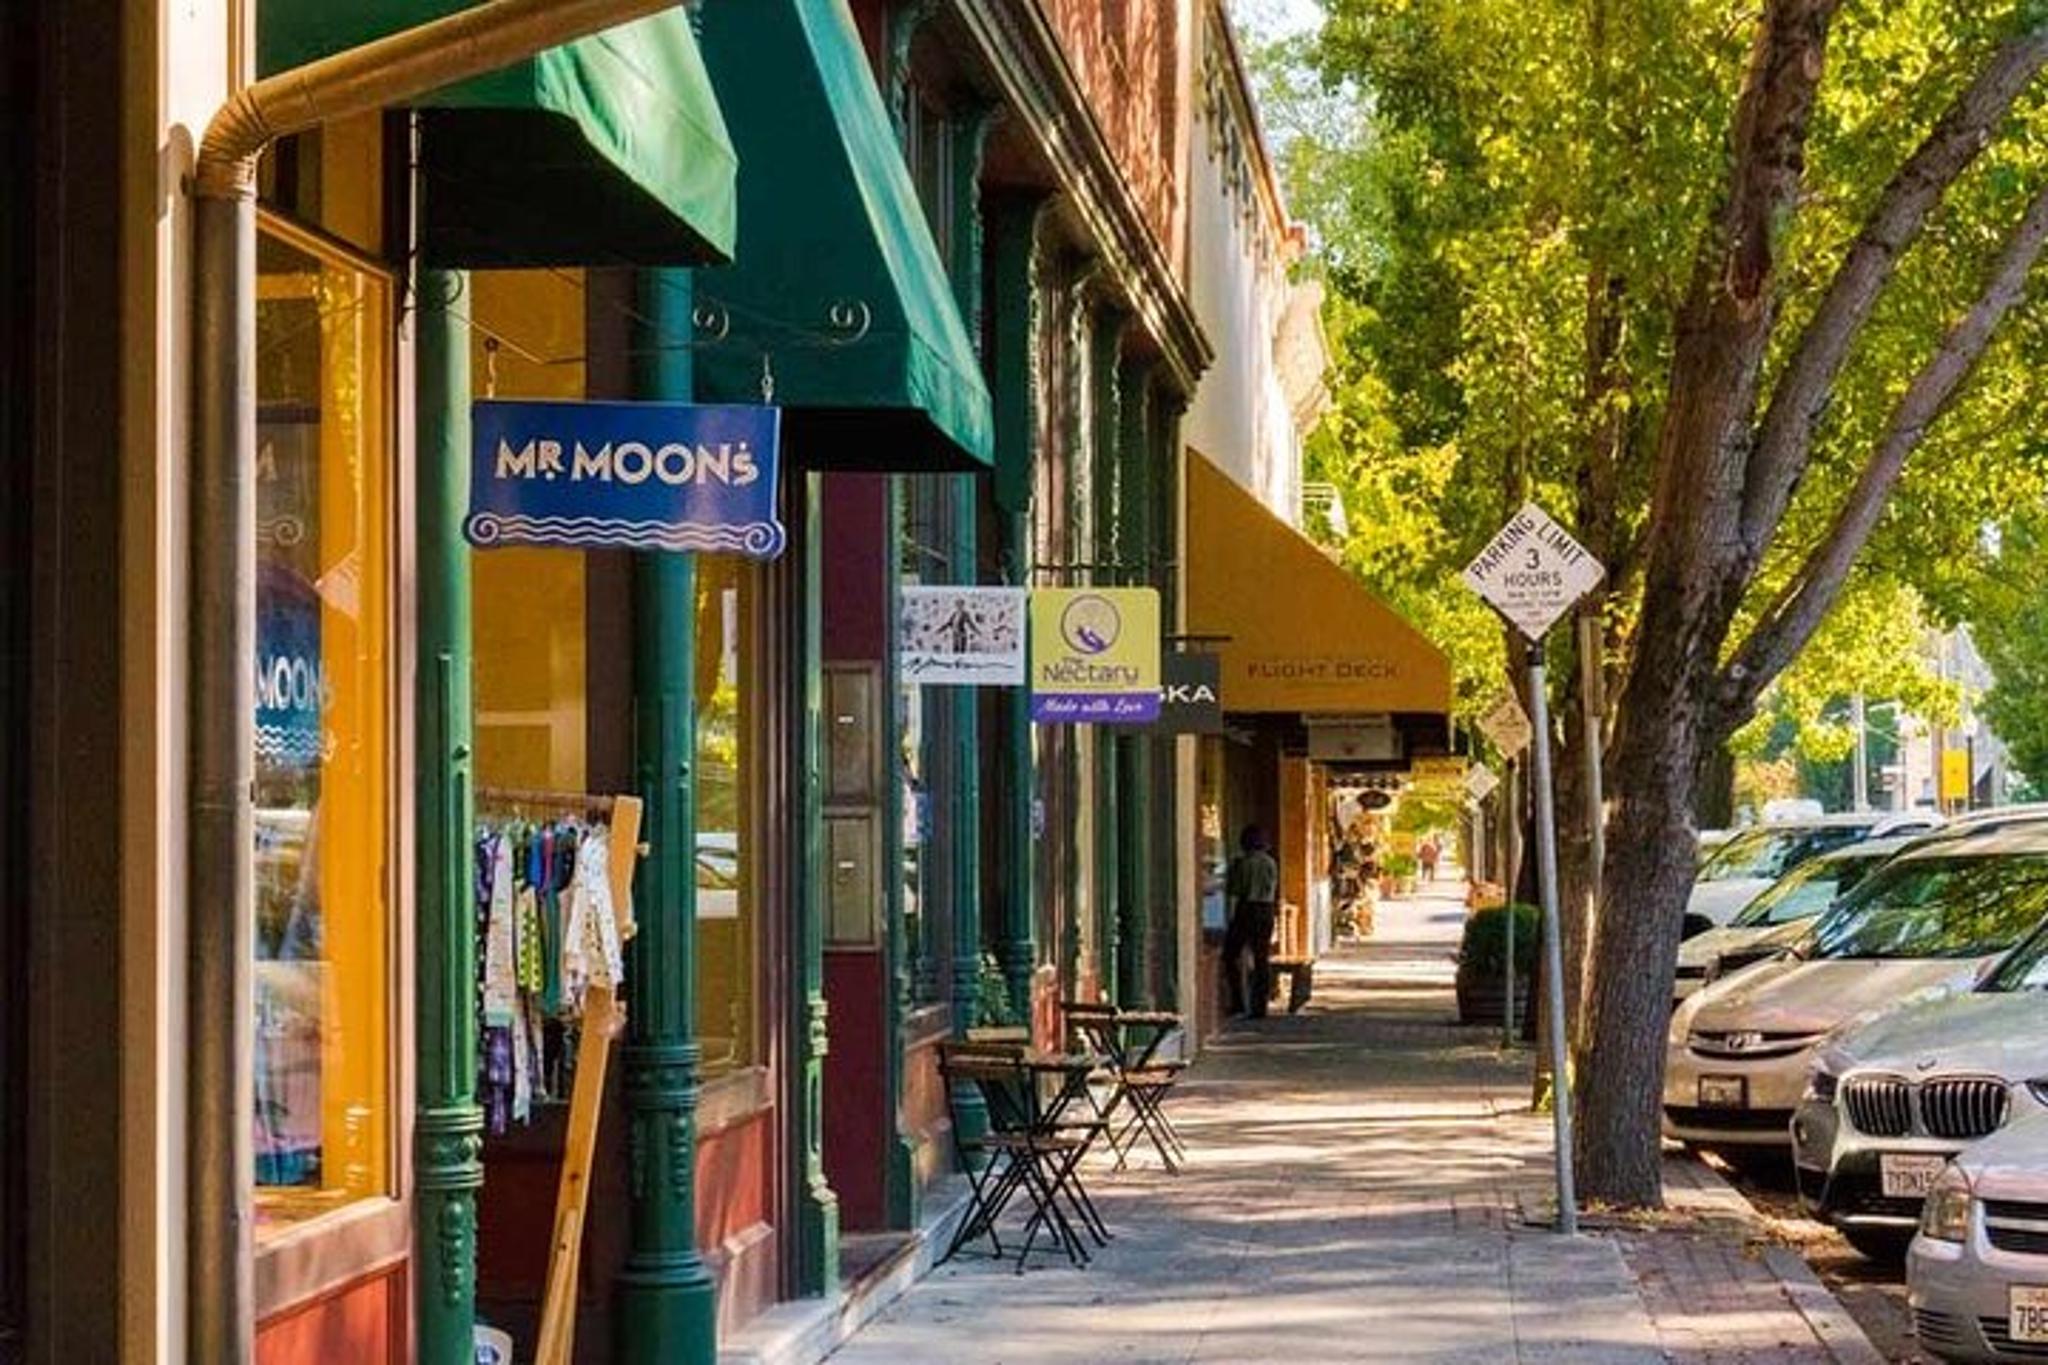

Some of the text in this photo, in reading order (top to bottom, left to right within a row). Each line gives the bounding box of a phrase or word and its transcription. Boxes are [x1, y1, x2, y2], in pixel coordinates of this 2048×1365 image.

[1471, 515, 1584, 580] PARKING LIMIT
[1526, 548, 1540, 570] 3
[1504, 570, 1563, 588] HOURS
[1043, 662, 1139, 686] Nectary
[1247, 660, 1399, 679] FLIGHT DECK
[1160, 684, 1216, 703] KA
